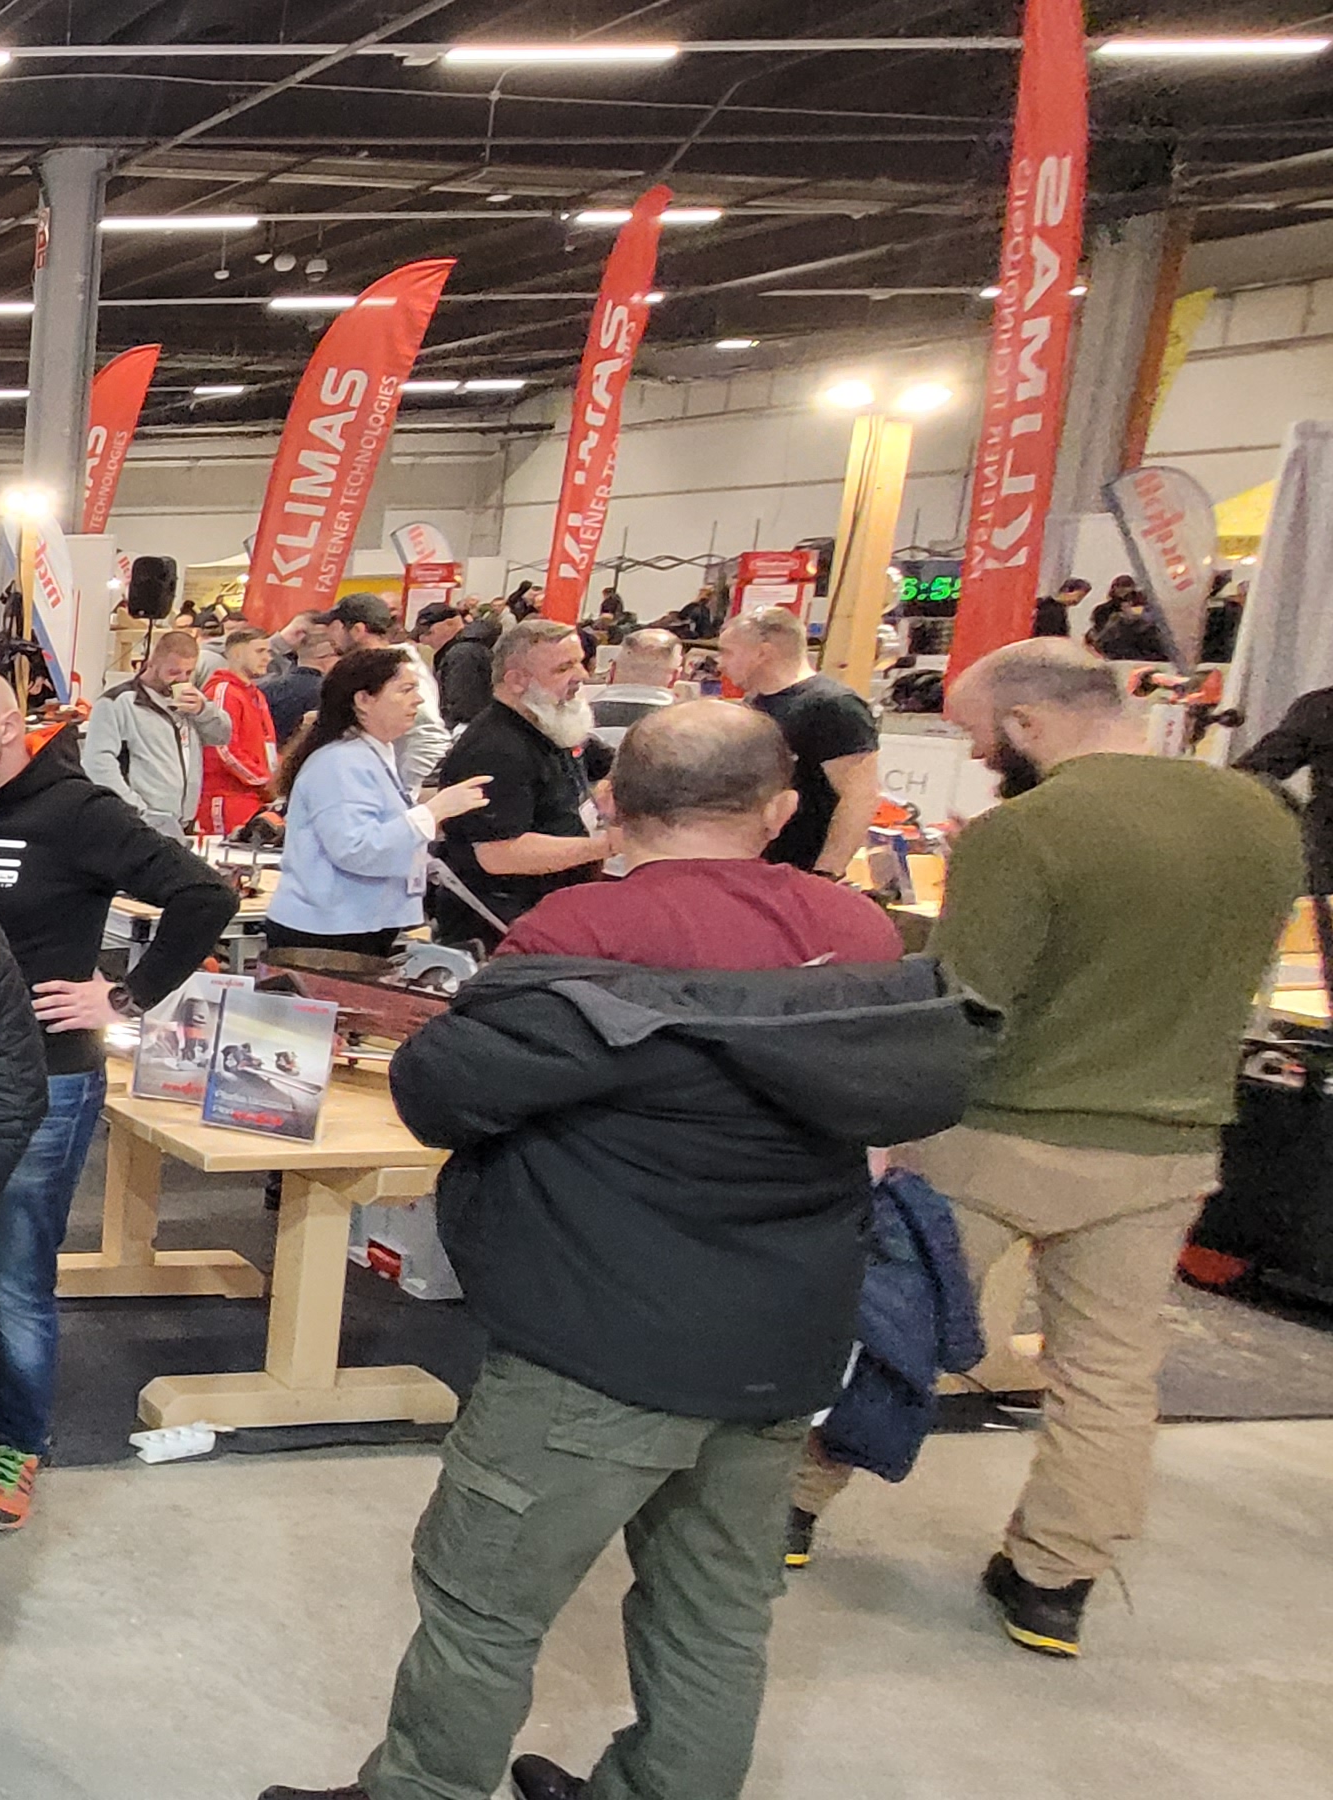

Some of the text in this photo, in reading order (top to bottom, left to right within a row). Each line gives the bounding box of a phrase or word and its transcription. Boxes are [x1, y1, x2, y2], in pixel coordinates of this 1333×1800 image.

[89, 430, 129, 530] TECHNOLOGIES
[265, 367, 369, 588] KLIMAS
[314, 375, 398, 593] FASTENER TECHNOLOGIES
